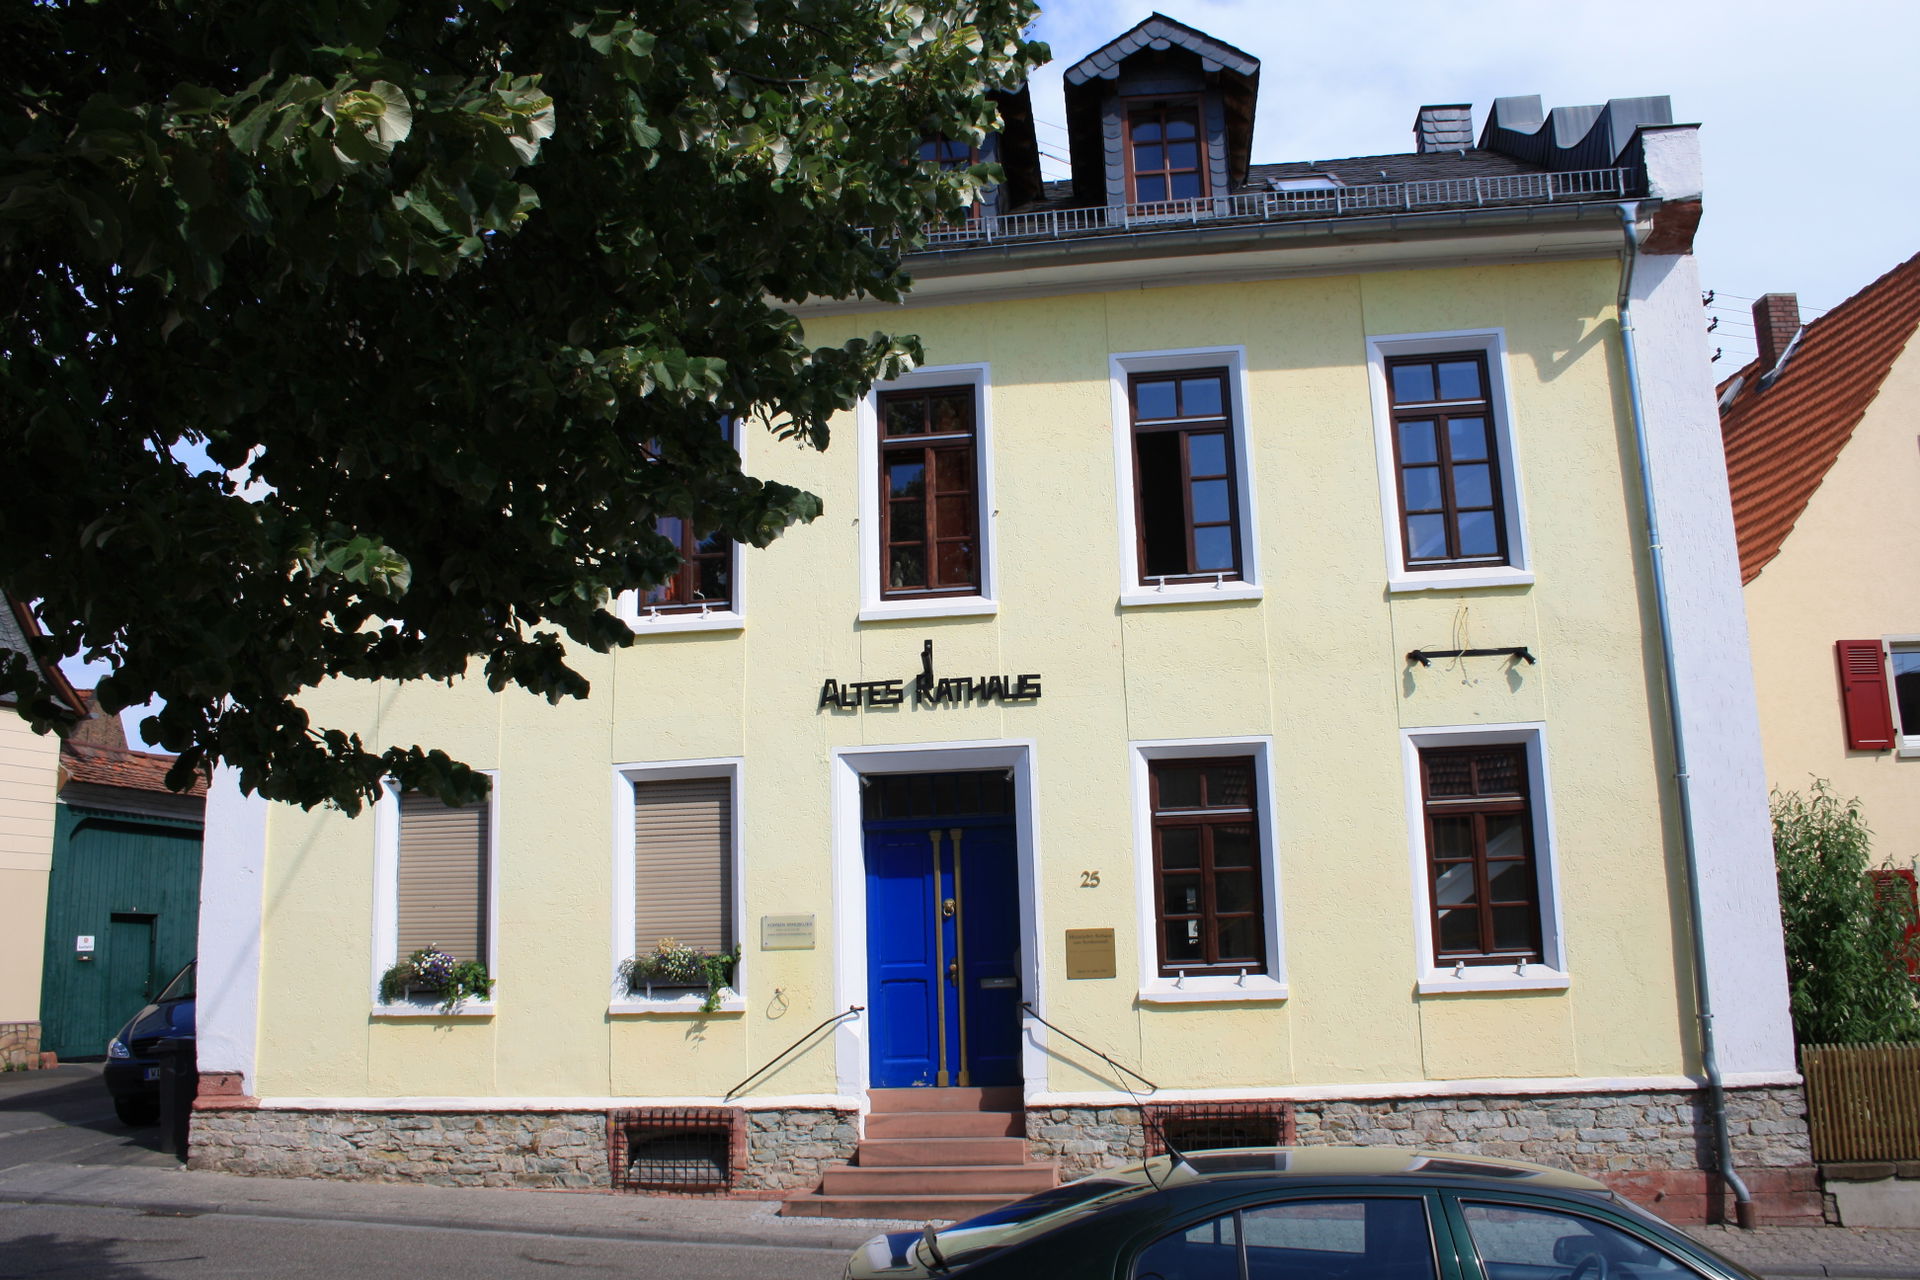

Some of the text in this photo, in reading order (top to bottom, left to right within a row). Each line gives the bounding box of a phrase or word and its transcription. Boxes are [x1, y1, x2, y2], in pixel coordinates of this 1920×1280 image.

[820, 673, 1042, 708] ALTES RATHAUS
[1080, 870, 1101, 889] 25
